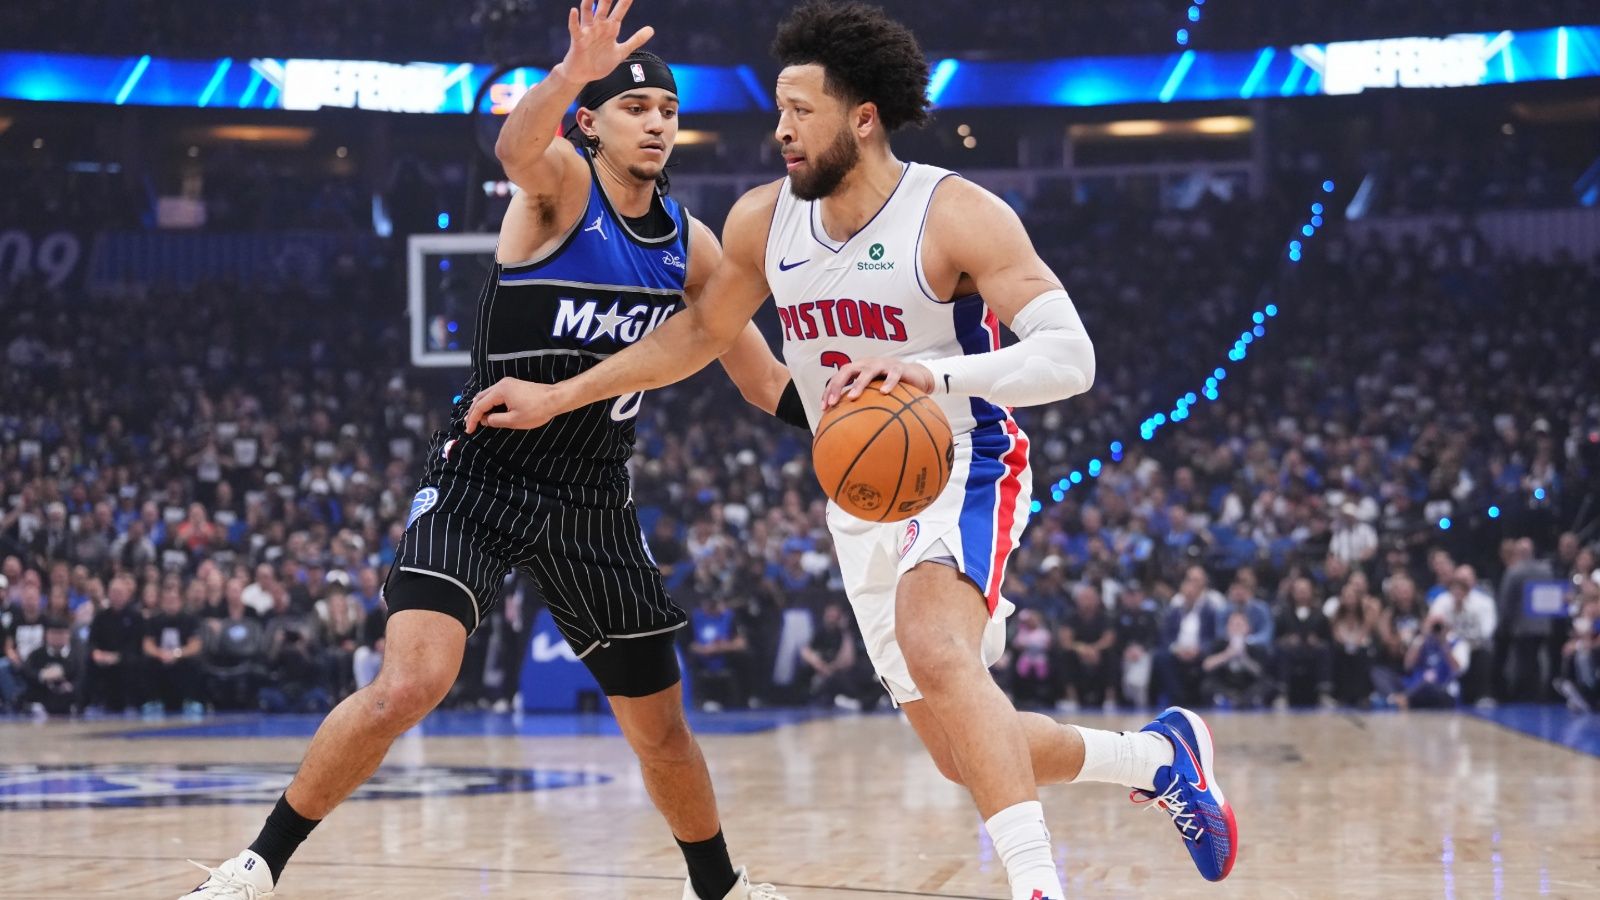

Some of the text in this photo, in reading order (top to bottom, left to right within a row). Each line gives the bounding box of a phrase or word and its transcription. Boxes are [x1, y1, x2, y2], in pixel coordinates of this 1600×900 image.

[662, 250, 686, 269] Disn
[857, 261, 895, 271] StockX
[778, 298, 908, 342] PISTONS
